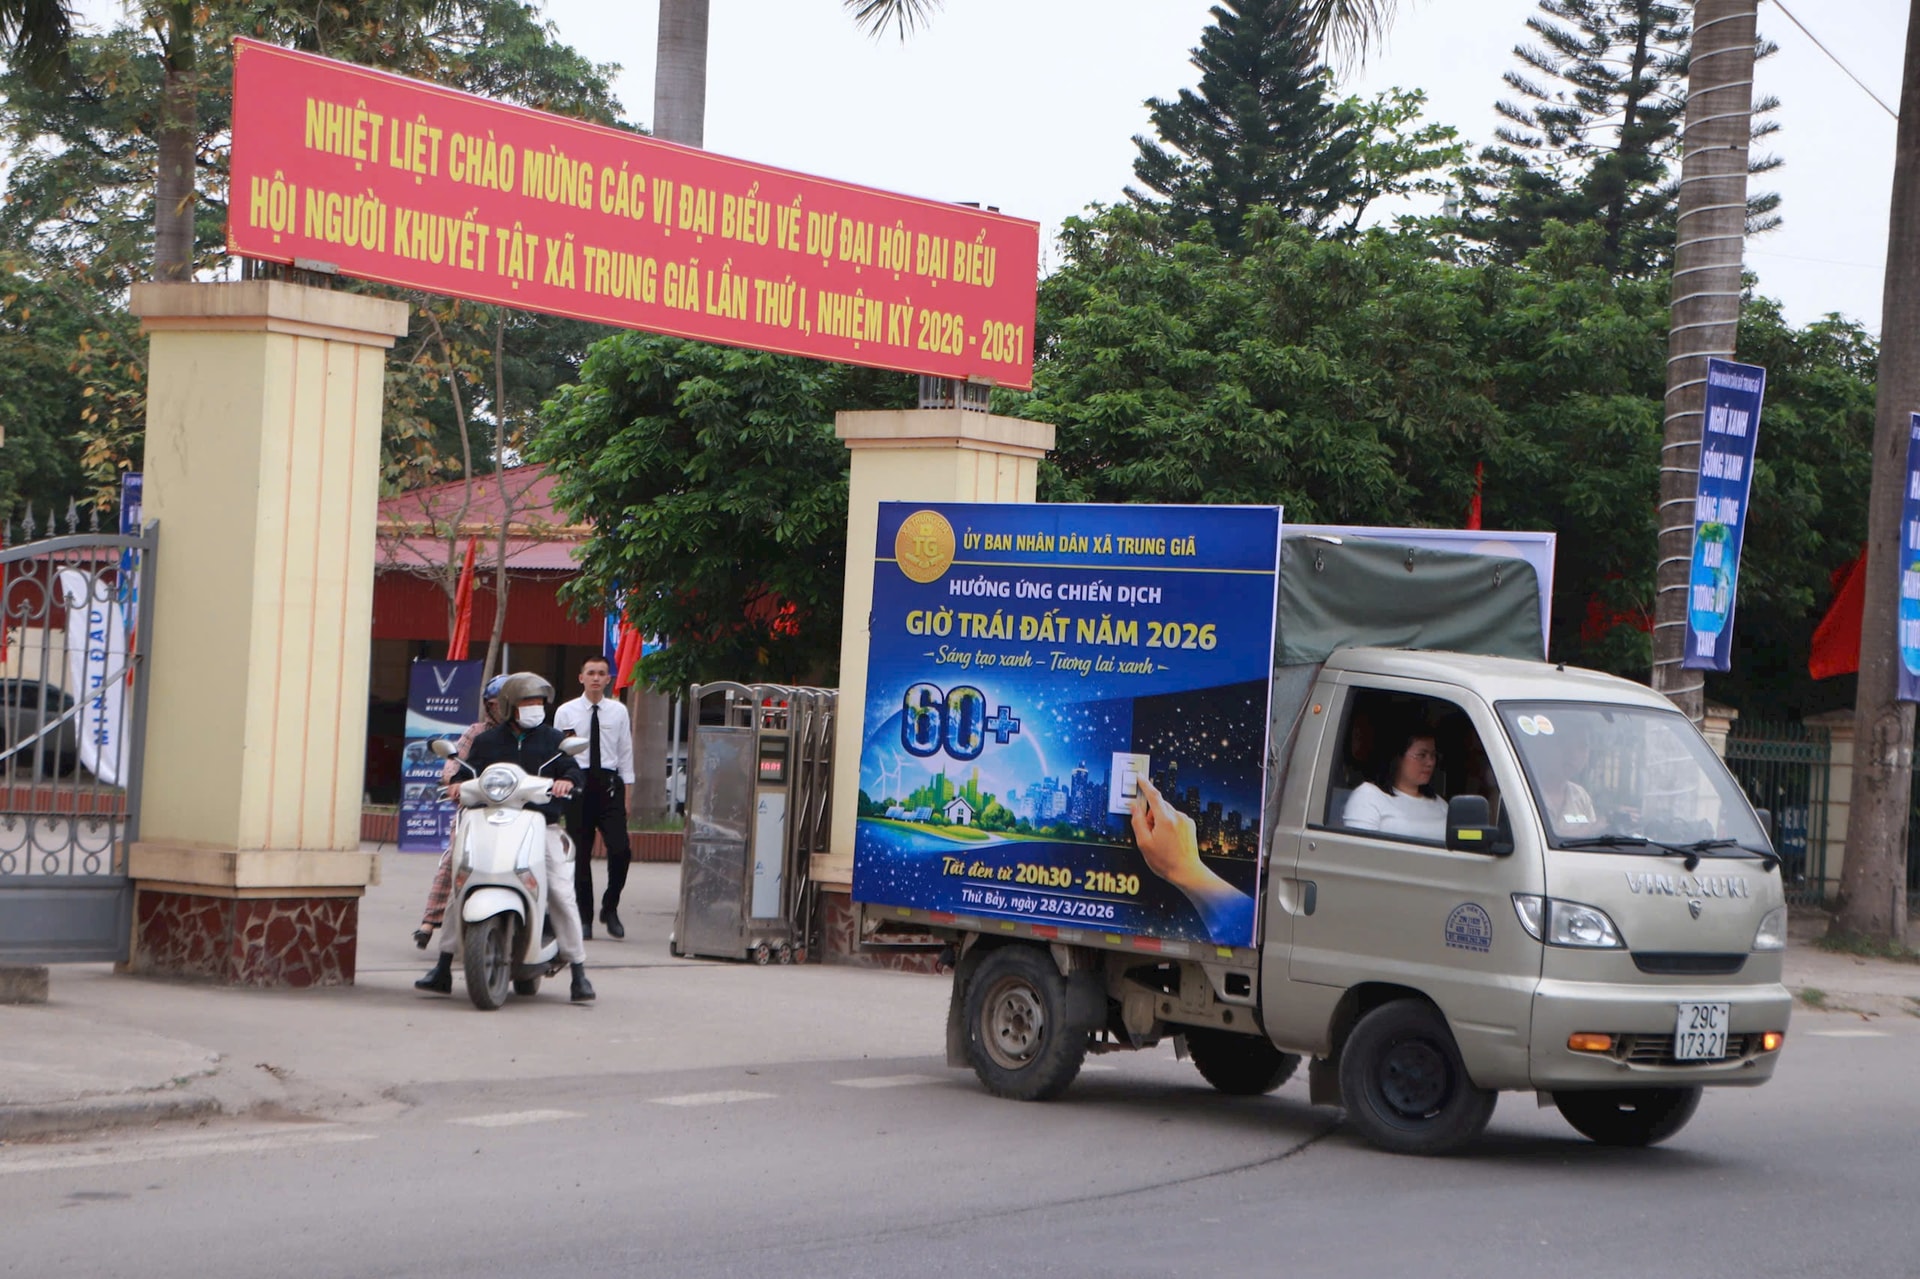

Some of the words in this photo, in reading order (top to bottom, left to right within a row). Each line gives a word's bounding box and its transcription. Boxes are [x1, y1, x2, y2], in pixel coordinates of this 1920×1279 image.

[305, 97, 383, 171] NHIỆT
[390, 114, 443, 184] LIỆT
[449, 129, 515, 192] CHÀO
[521, 145, 594, 210] MỪNG
[600, 161, 646, 220] CÁC
[653, 178, 674, 237] VỊ
[678, 184, 715, 243] ĐẠI
[721, 181, 771, 246] BIỂU
[776, 193, 803, 253] VỀ
[806, 211, 838, 267] DỰ
[839, 218, 874, 274] ĐẠI
[878, 219, 911, 280] HỘI
[916, 233, 948, 288] ĐẠI
[953, 228, 996, 288] BIỂU
[250, 170, 296, 243] HỘI
[304, 188, 387, 253] NGƯỜI
[394, 207, 490, 272] KHUYẾT
[496, 222, 539, 289] TẬT
[544, 232, 576, 289] XÃ
[583, 245, 657, 304] TRUNG
[663, 258, 700, 313] GIÃ
[706, 257, 748, 320] LẦN
[754, 274, 798, 328] THỨ
[798, 287, 811, 337] I,
[817, 288, 883, 350] NHIỆM
[888, 296, 914, 348] KỲ
[918, 309, 964, 356] 2026
[981, 320, 1024, 365] 2031
[912, 536, 938, 558] TG
[963, 527, 982, 551] ỦY
[984, 533, 1012, 551] BAN
[1016, 532, 1055, 552] NHÂN
[1059, 532, 1088, 553] DÂN
[1092, 533, 1113, 554] XÃ
[1117, 537, 1165, 555] TRUNG
[1170, 535, 1196, 556] GIÃ
[949, 575, 1010, 598] HƯỞNG
[1015, 579, 1052, 599] ỨNG
[1057, 580, 1112, 602] CHIẾN
[1117, 586, 1162, 607] DỊCH
[905, 605, 954, 637] GIỜ
[958, 609, 1014, 640] TRÁI
[1019, 608, 1071, 642] ĐẤT
[1076, 613, 1139, 647] NĂM
[1146, 621, 1217, 650] 2026
[935, 645, 972, 670] Sáng
[975, 649, 997, 669] tạo
[998, 650, 1033, 668] xanh
[1050, 651, 1092, 677] Tương
[1095, 654, 1115, 673] lai
[1118, 657, 1155, 674] xanh
[901, 682, 1021, 761] 60+
[405, 769, 433, 778] LIMO
[967, 860, 994, 879] đèn
[997, 865, 1014, 882] từ
[1015, 862, 1072, 888] 20h30
[1084, 871, 1140, 896] 21h30
[1625, 872, 1749, 899] VINAXUKI
[961, 889, 983, 903] Thứ
[984, 891, 1008, 909] Bảy,
[1010, 895, 1038, 913] ngày
[1039, 898, 1115, 919] 28/3/2026
[1689, 1005, 1719, 1030] 29C
[1679, 1032, 1725, 1057] 173.21
